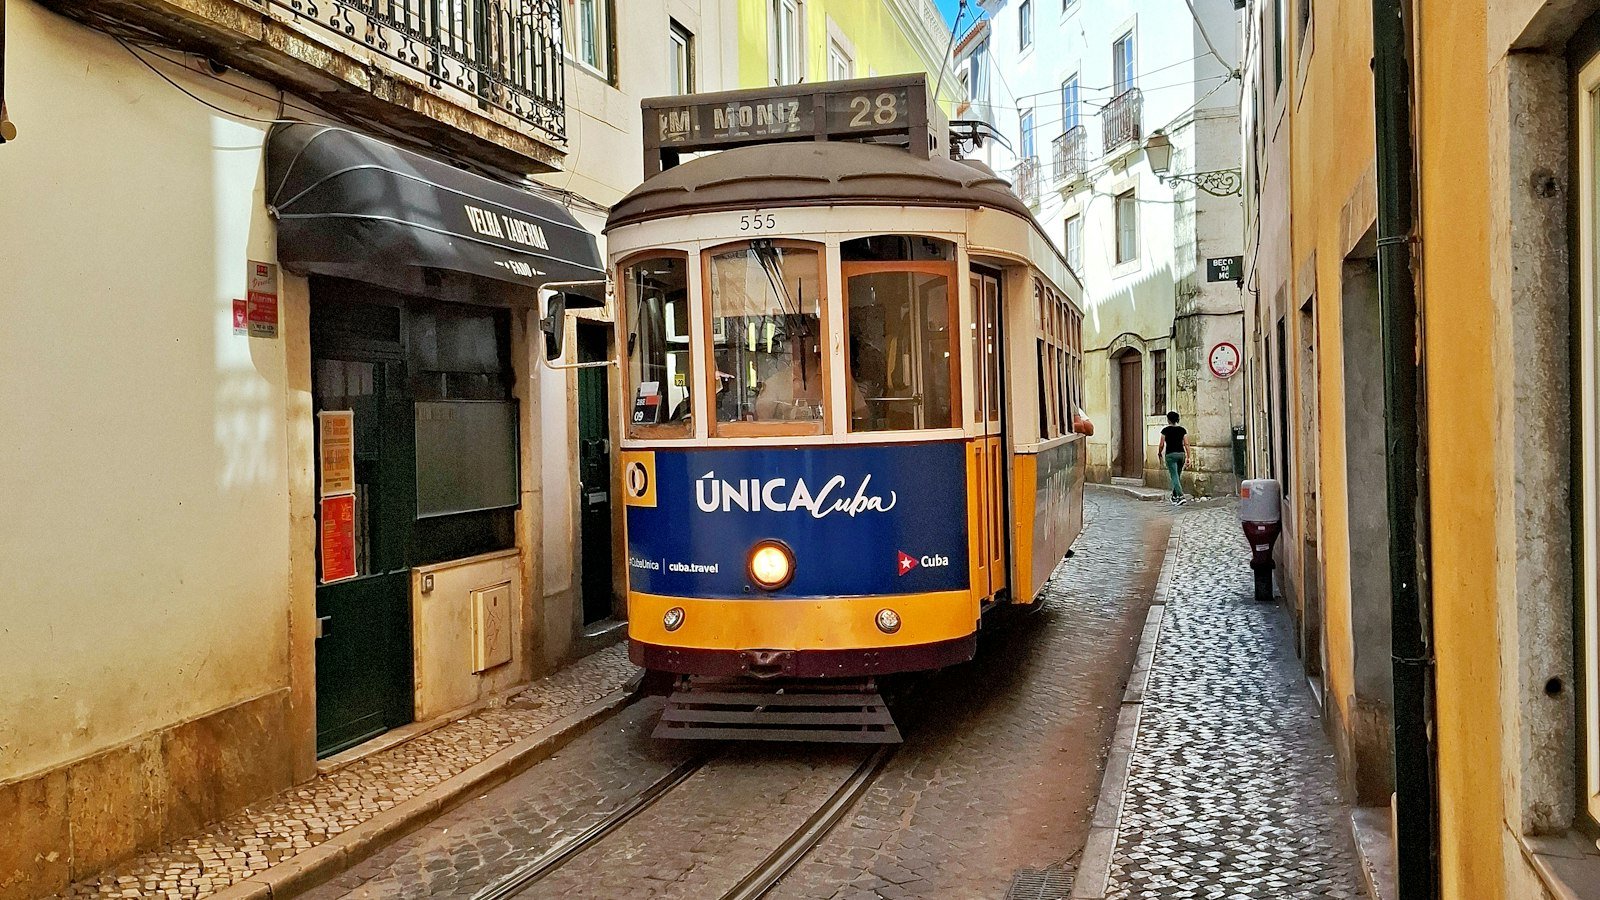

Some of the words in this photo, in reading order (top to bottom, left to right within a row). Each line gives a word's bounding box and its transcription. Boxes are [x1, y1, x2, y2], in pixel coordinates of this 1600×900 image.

[713, 101, 800, 129] MONIZ
[850, 92, 898, 127] 28
[464, 204, 505, 239] VELHA
[501, 215, 550, 251] TABERNA
[740, 213, 776, 231] 555
[508, 260, 532, 278] FADO
[1212, 258, 1234, 266] BECO
[634, 411, 644, 422] 09
[668, 562, 719, 573] cuba.travel
[920, 554, 949, 568] Cuba
